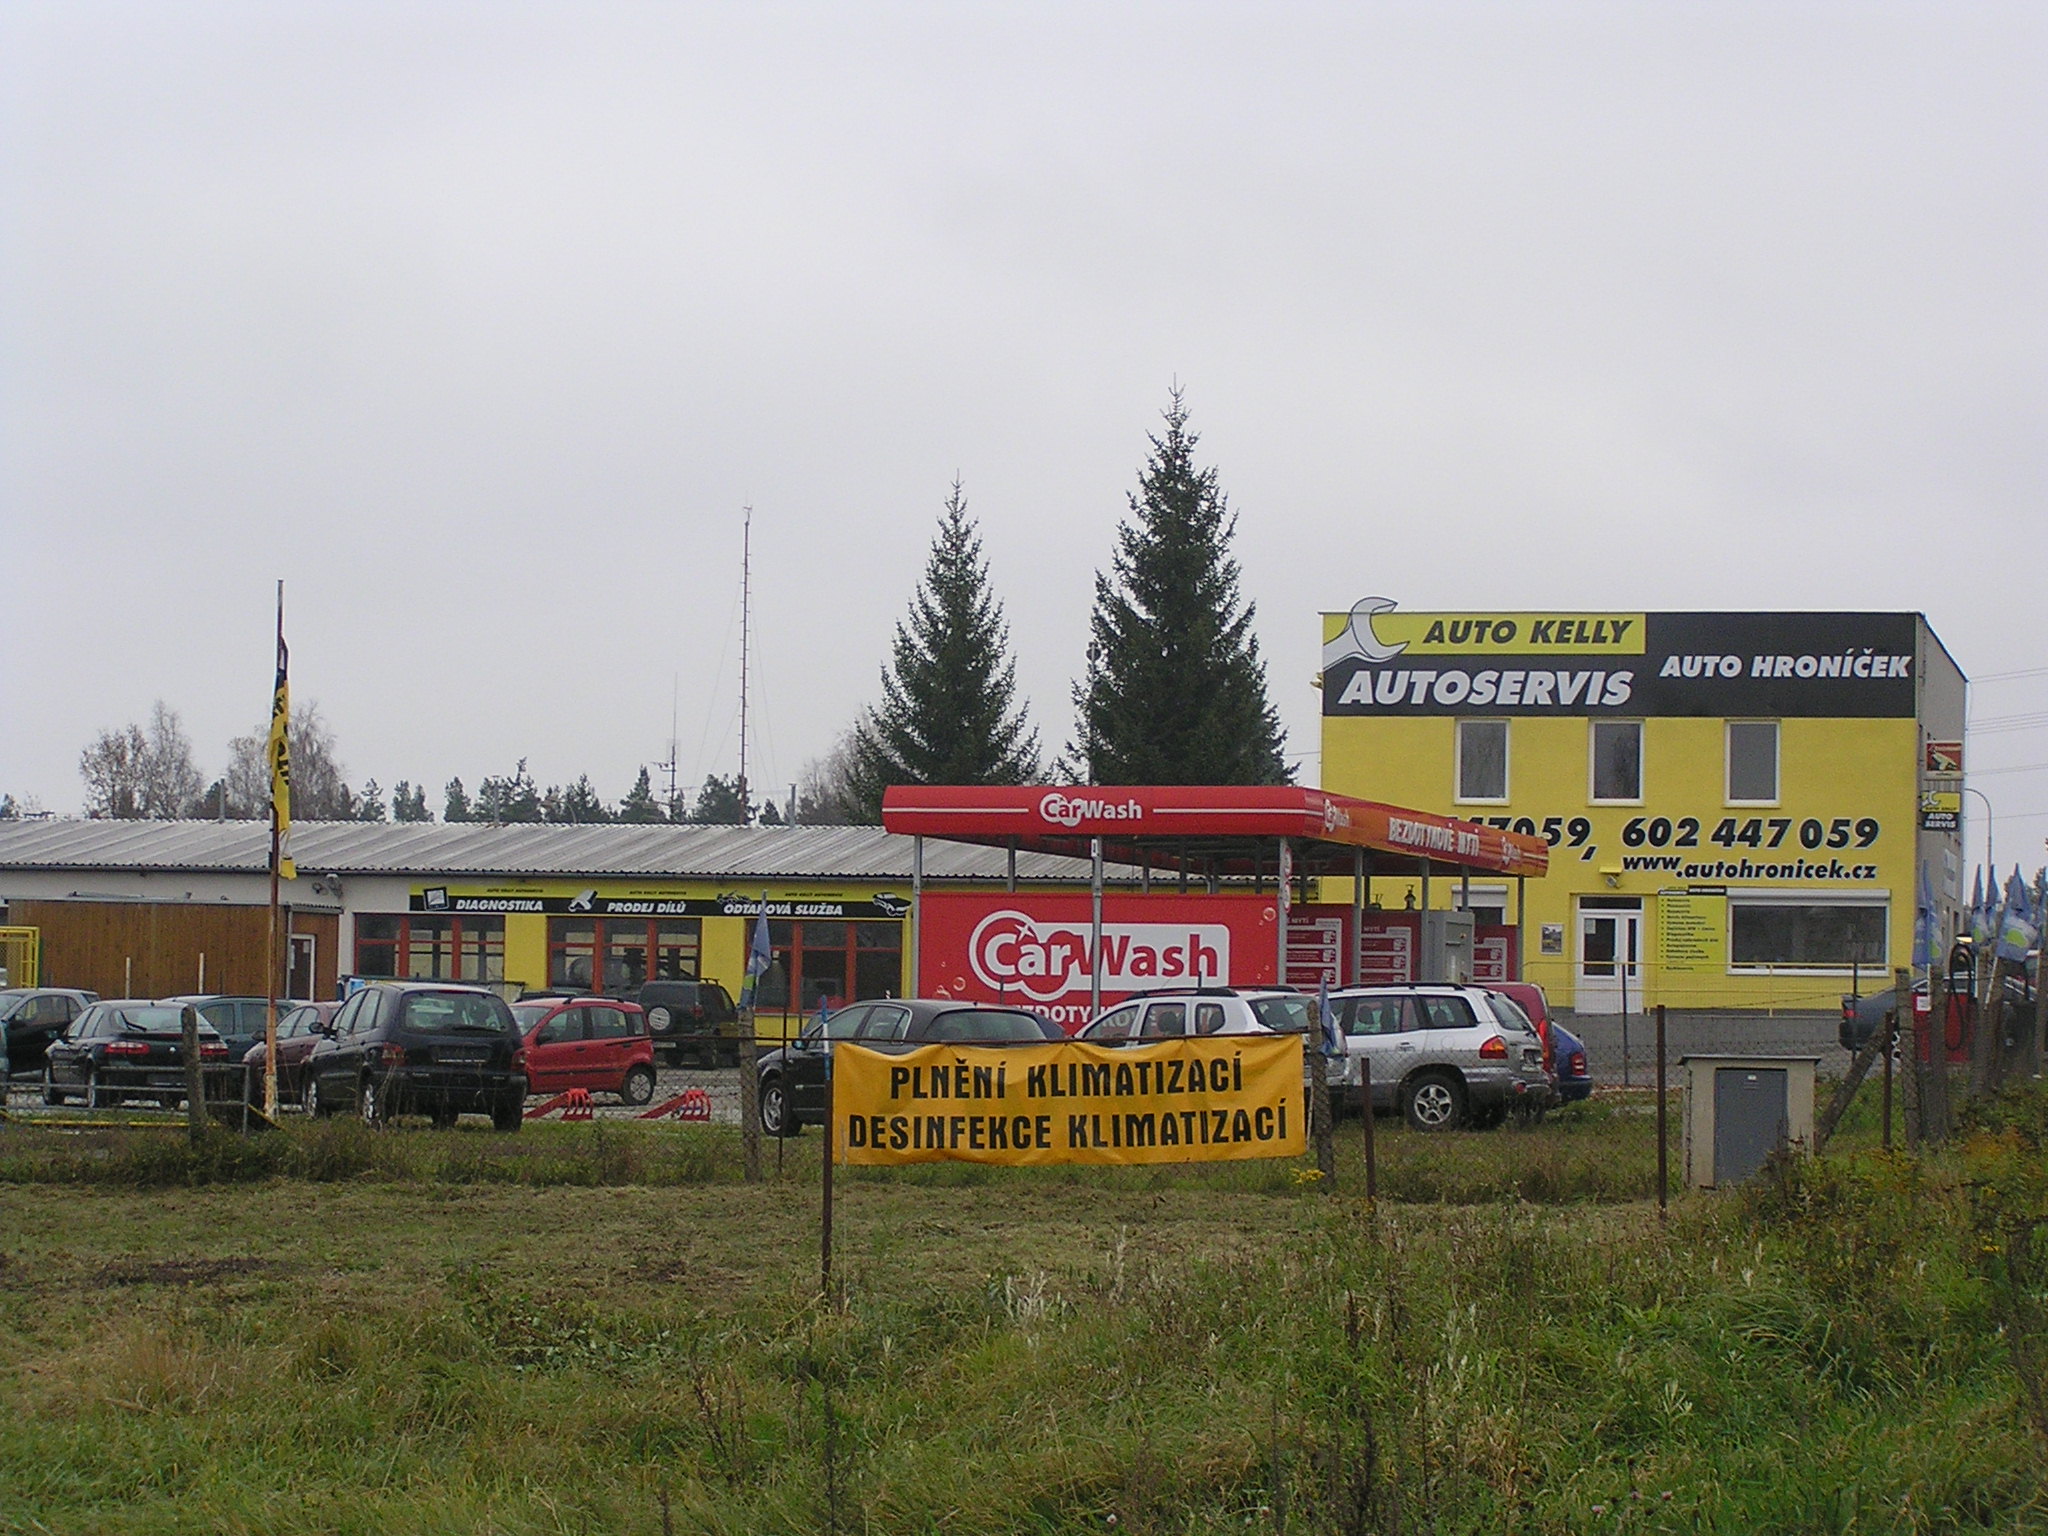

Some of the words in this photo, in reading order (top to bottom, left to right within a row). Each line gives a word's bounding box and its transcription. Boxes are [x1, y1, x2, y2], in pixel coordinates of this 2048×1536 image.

[1423, 620, 1517, 644] AUTO
[1529, 620, 1633, 644] KELLY
[1660, 655, 1742, 679] AUTO
[1750, 646, 1911, 680] HRONÍČEK
[1338, 670, 1634, 707] AUTOSERVIS
[1042, 797, 1142, 821] CarWash
[1622, 817, 1701, 848] 602
[1710, 817, 1793, 848] 447
[1799, 817, 1880, 849] 059
[1622, 856, 1877, 879] www.autohronicek.cz
[456, 898, 544, 911] DIAGNOSTIKA
[606, 902, 655, 913] PRODEJ
[656, 900, 687, 913] DÍLŮ
[794, 902, 843, 916] SLUŽBA
[984, 932, 1218, 977] CarWash
[890, 1058, 1007, 1100] PLNĚNÍ
[1027, 1050, 1243, 1098] KLIMATIZACÍ
[849, 1113, 1051, 1149] DESINFEKCE
[1068, 1098, 1288, 1148] KLIMATIZACÍ
